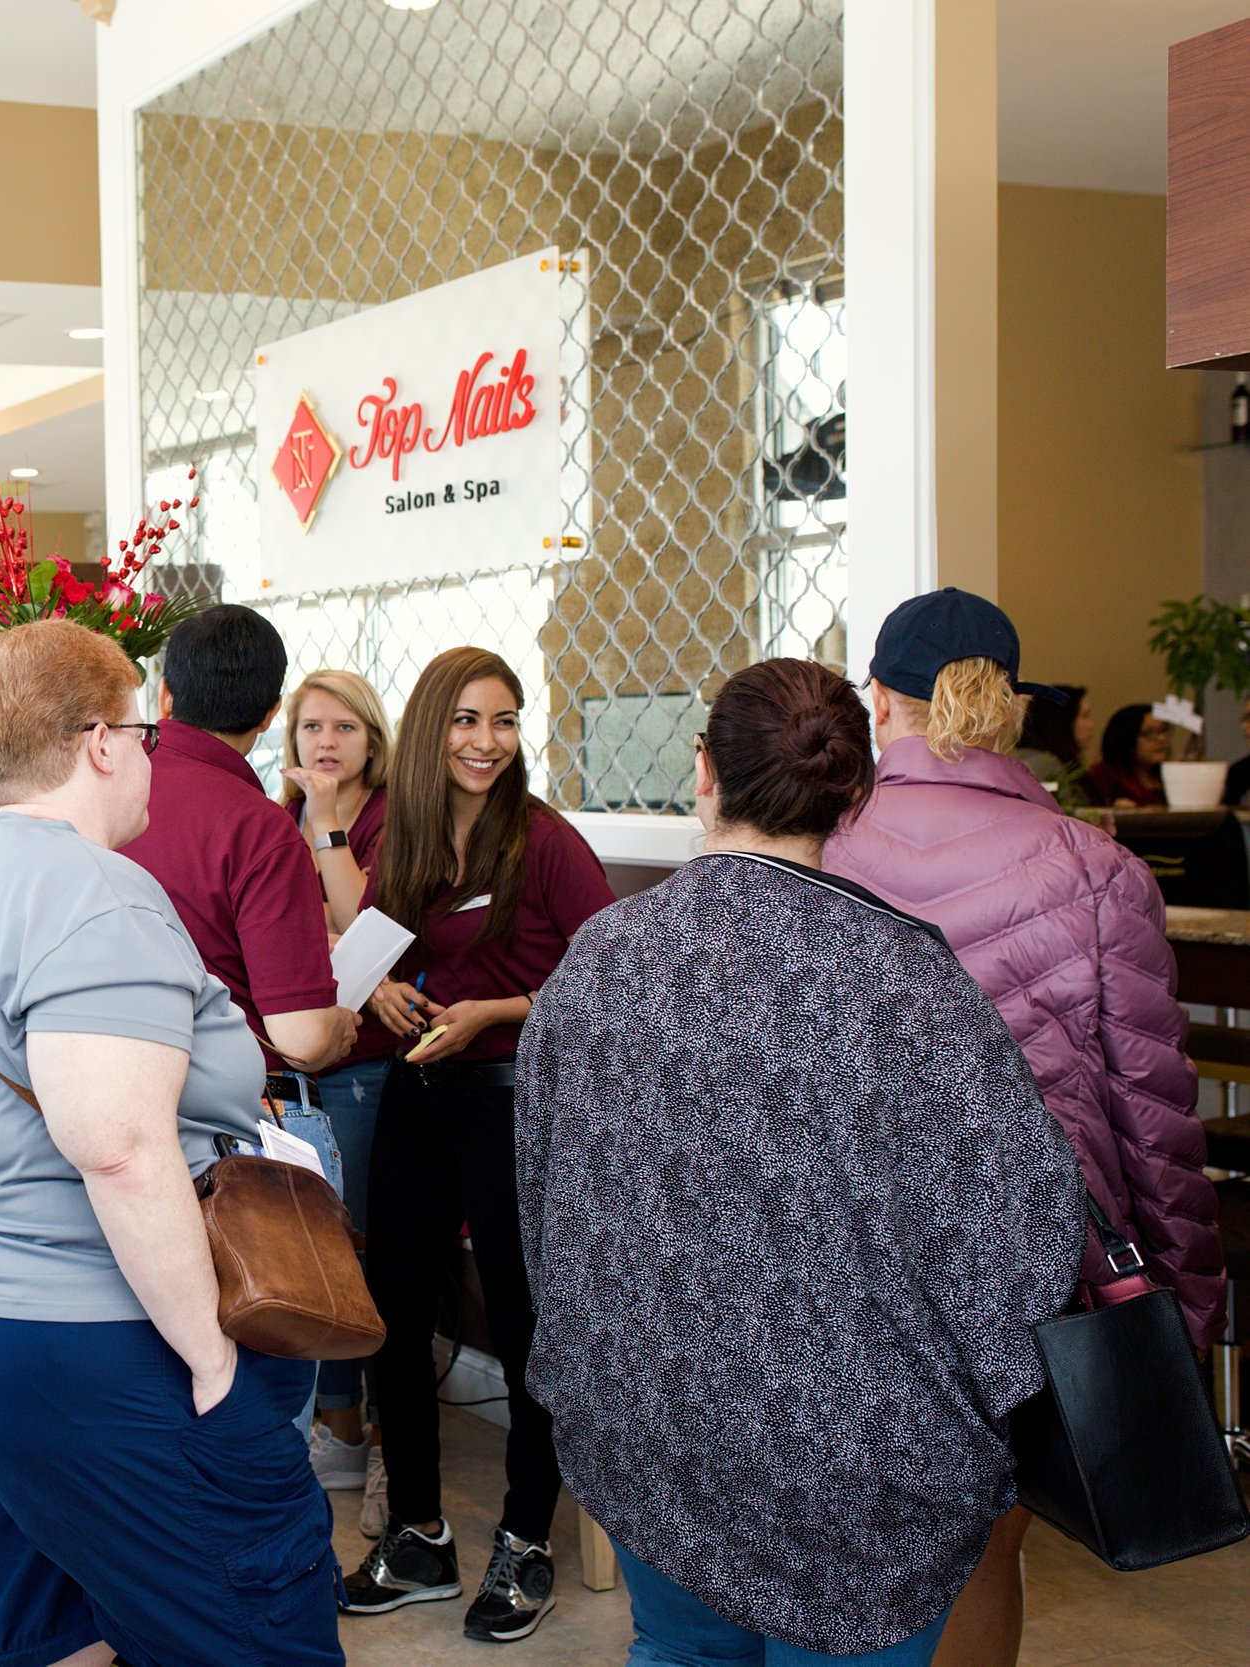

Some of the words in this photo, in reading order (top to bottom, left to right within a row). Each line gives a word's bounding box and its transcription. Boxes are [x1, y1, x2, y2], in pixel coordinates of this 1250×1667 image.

[350, 377, 422, 481] Top
[423, 349, 537, 453] Nails
[385, 490, 436, 514] Salon
[444, 484, 456, 504] &
[464, 479, 501, 503] Spa
